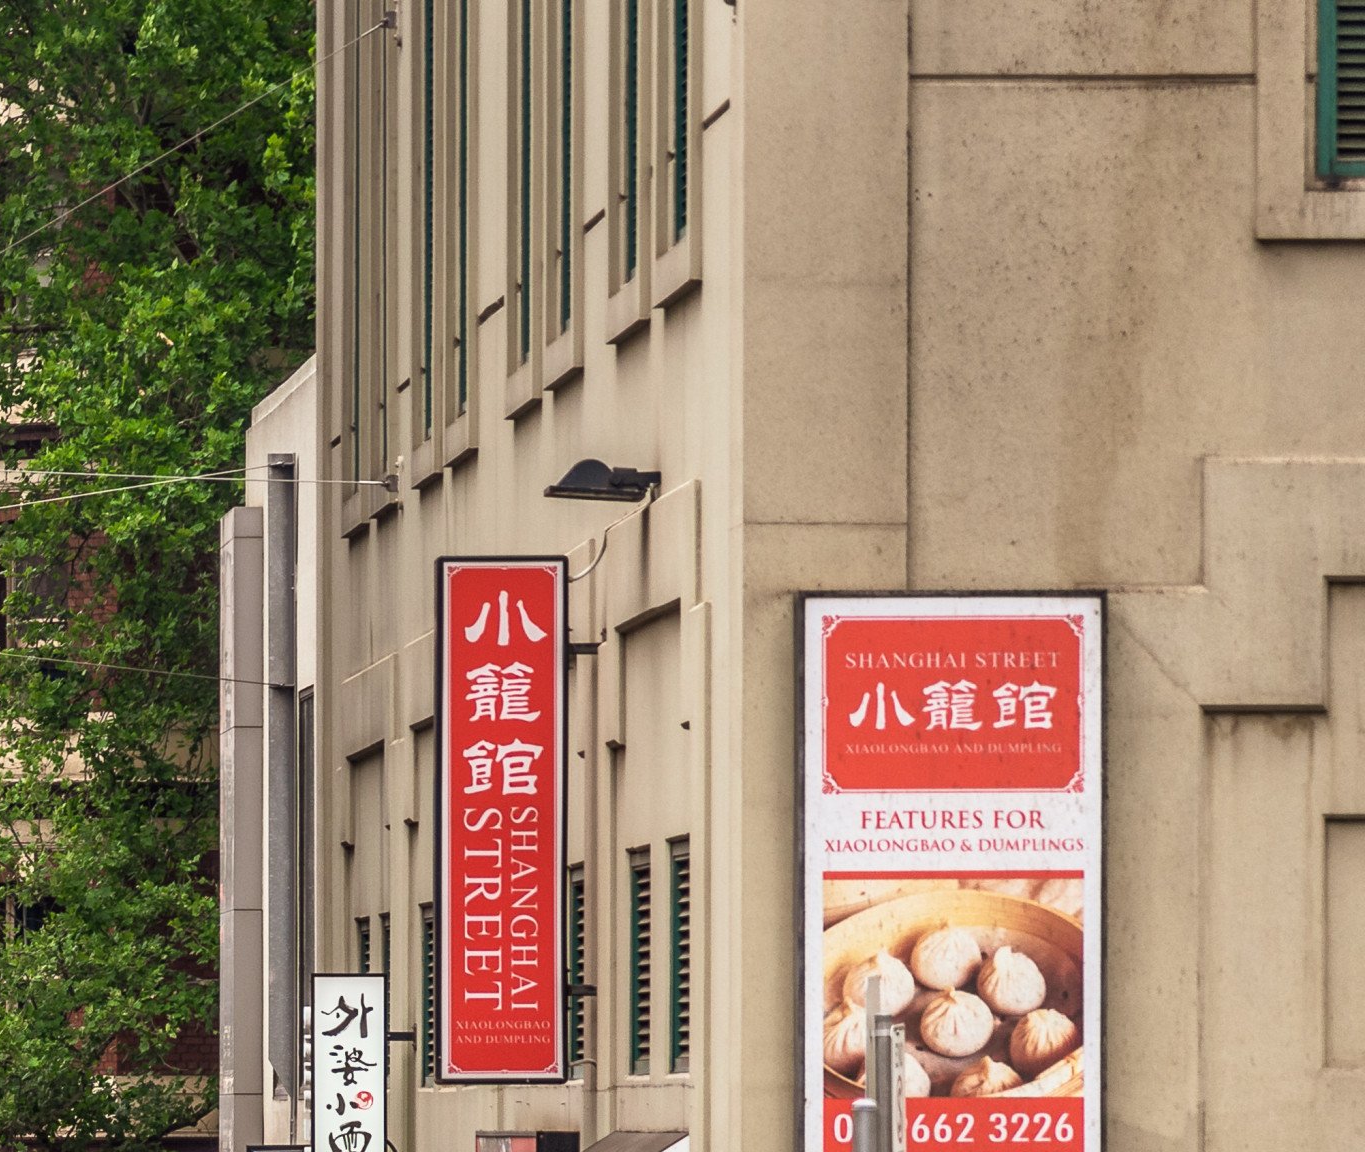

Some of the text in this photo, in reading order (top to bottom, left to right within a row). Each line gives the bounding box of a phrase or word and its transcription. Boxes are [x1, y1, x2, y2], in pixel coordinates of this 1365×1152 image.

[845, 652, 1061, 669] SHANGHAI STREET
[462, 590, 549, 796] 小籠館
[849, 679, 1058, 731] 小籠館
[845, 743, 1063, 754] XIAOLONGBAO AND DUMPLING
[860, 810, 1045, 830] FEATURES FOR
[824, 838, 1085, 853] XIAOLONGBAO & DUMPLINGS
[463, 807, 503, 1011] STREET
[509, 805, 539, 1011] SHANGHAI
[455, 1020, 551, 1030] XIAOLONGBAO
[455, 1034, 551, 1044] AND DUMPLING
[833, 1113, 1075, 1143] 0 662 3226
